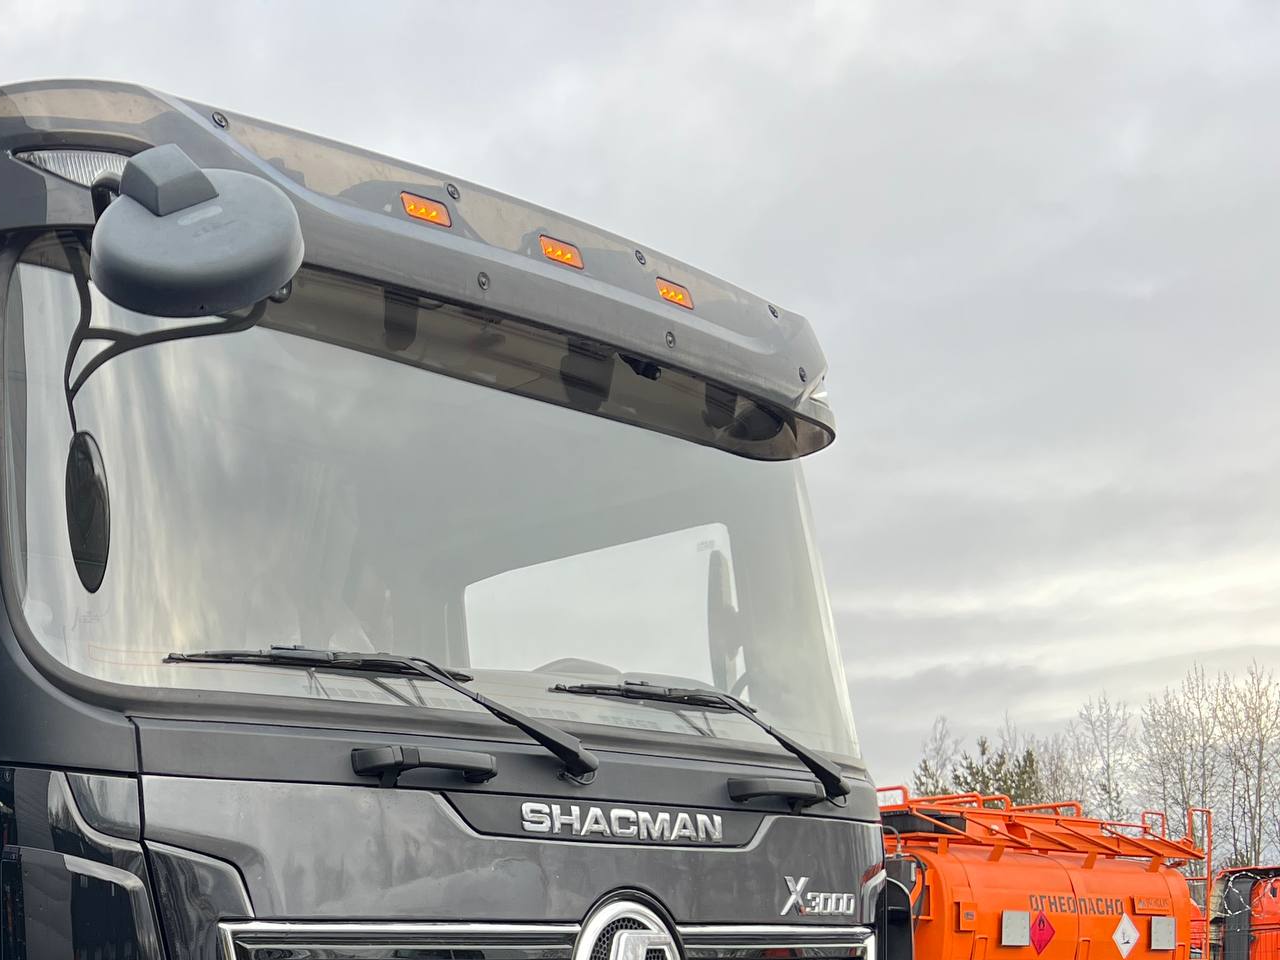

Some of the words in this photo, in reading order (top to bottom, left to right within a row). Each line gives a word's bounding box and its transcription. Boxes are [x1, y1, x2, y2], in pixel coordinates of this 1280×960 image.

[521, 801, 722, 843] SHACMAN
[780, 876, 855, 916] X3000
[1029, 895, 1125, 915] ОГНЕОПАСНО
